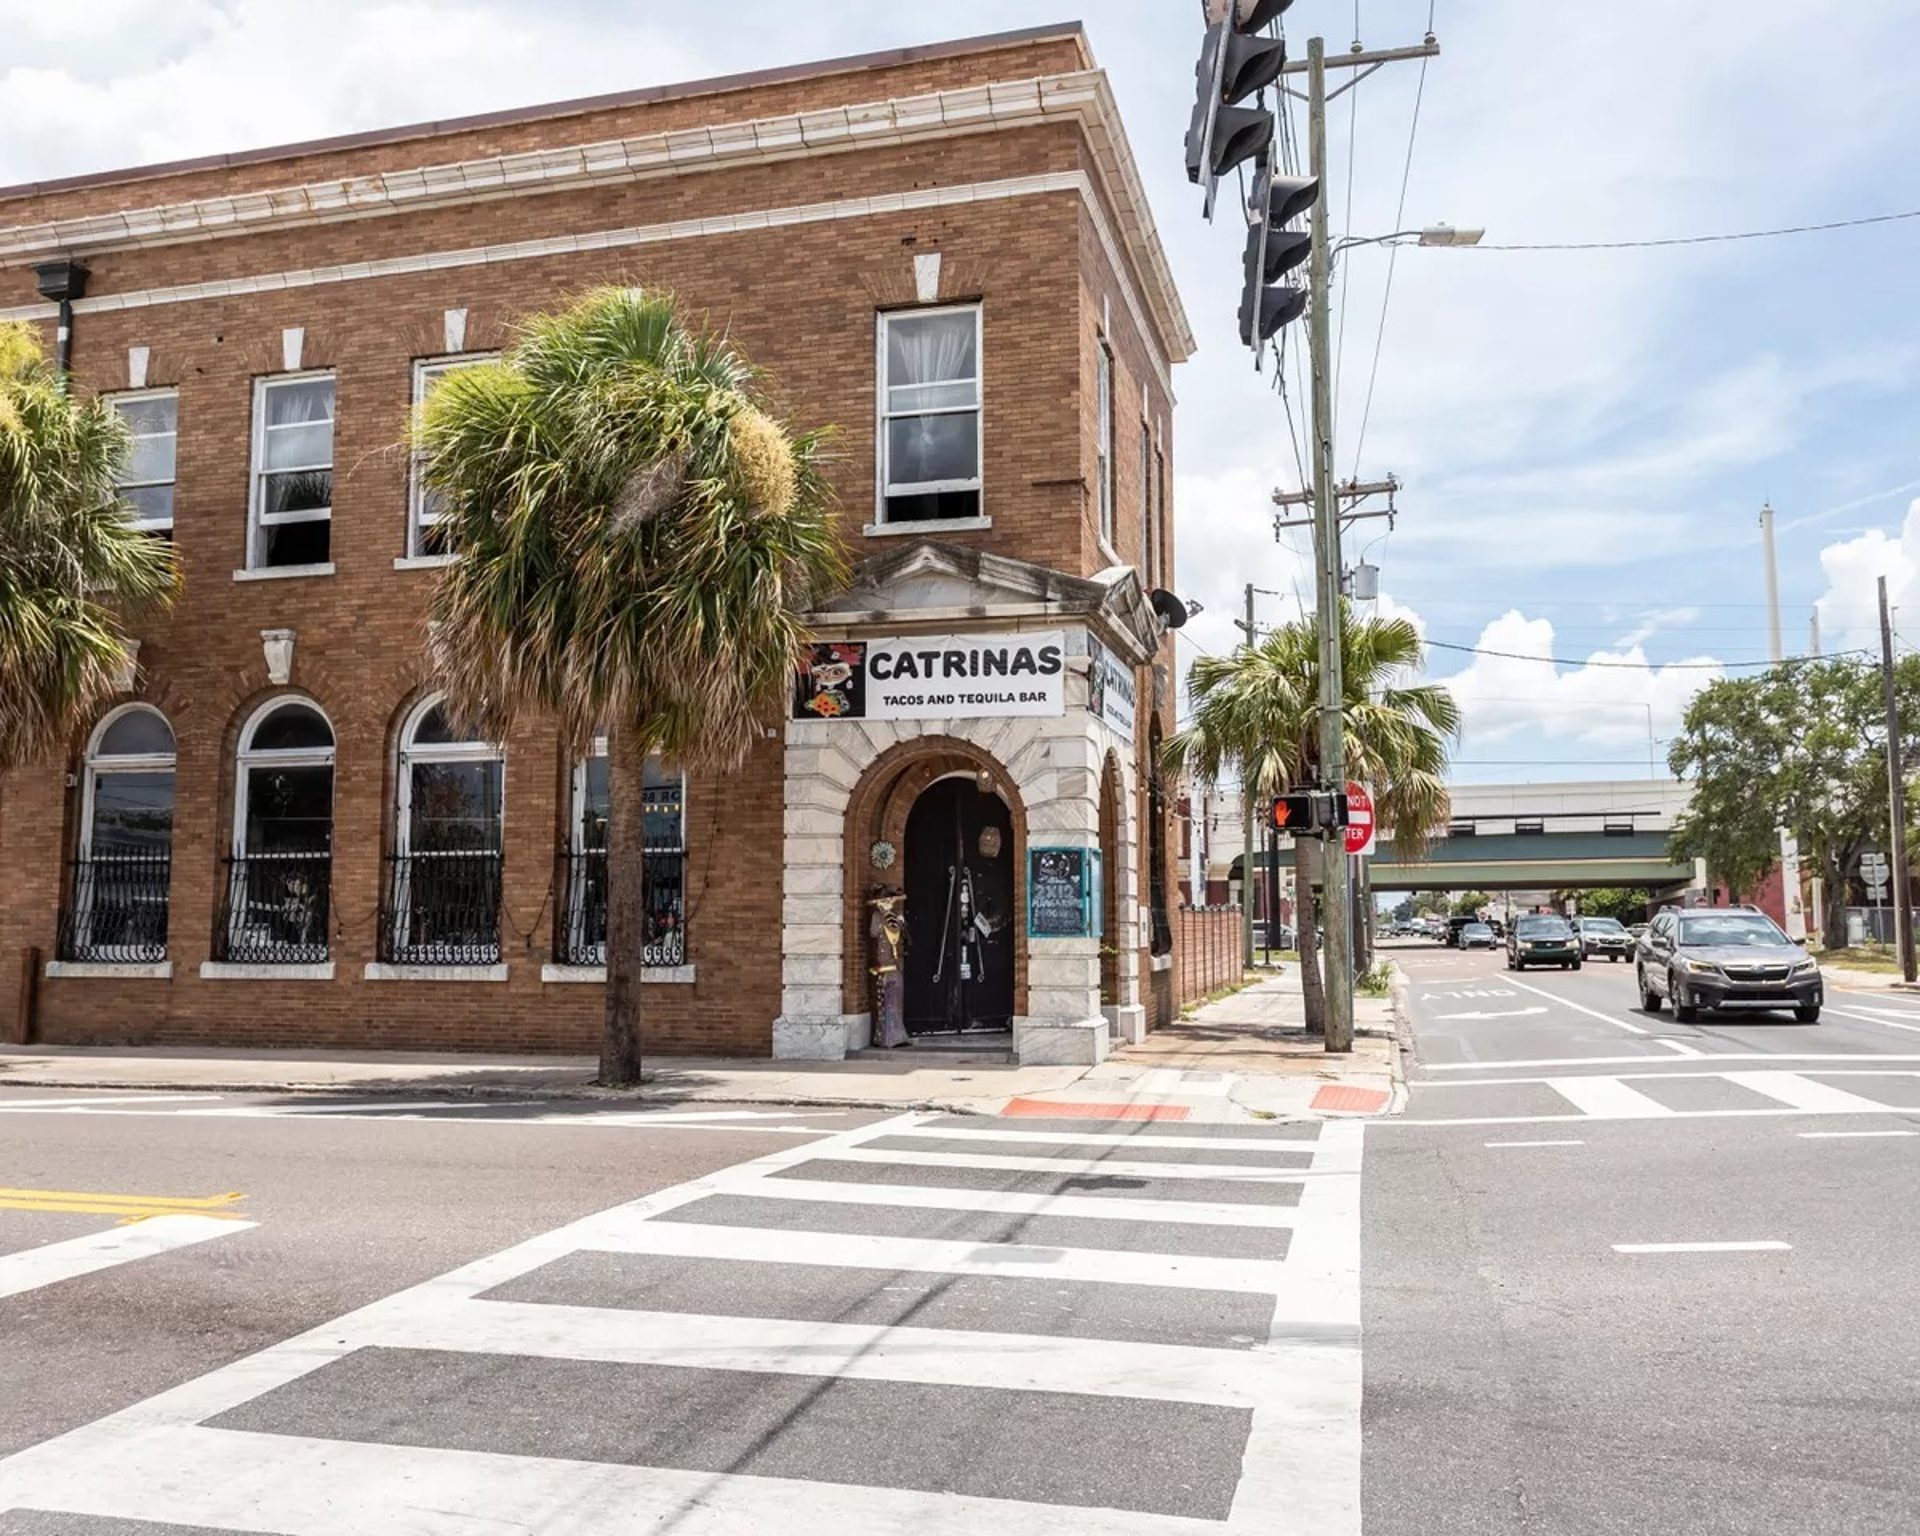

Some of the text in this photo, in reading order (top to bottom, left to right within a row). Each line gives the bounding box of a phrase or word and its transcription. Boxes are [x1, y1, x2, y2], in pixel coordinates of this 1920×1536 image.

[870, 646, 1062, 680] CATRINAS
[883, 691, 1047, 706] TACOS AND TEQUILA BAR
[1347, 795, 1366, 807] NOT
[1345, 828, 1364, 839] TER
[1420, 989, 1518, 1001] ONLY
